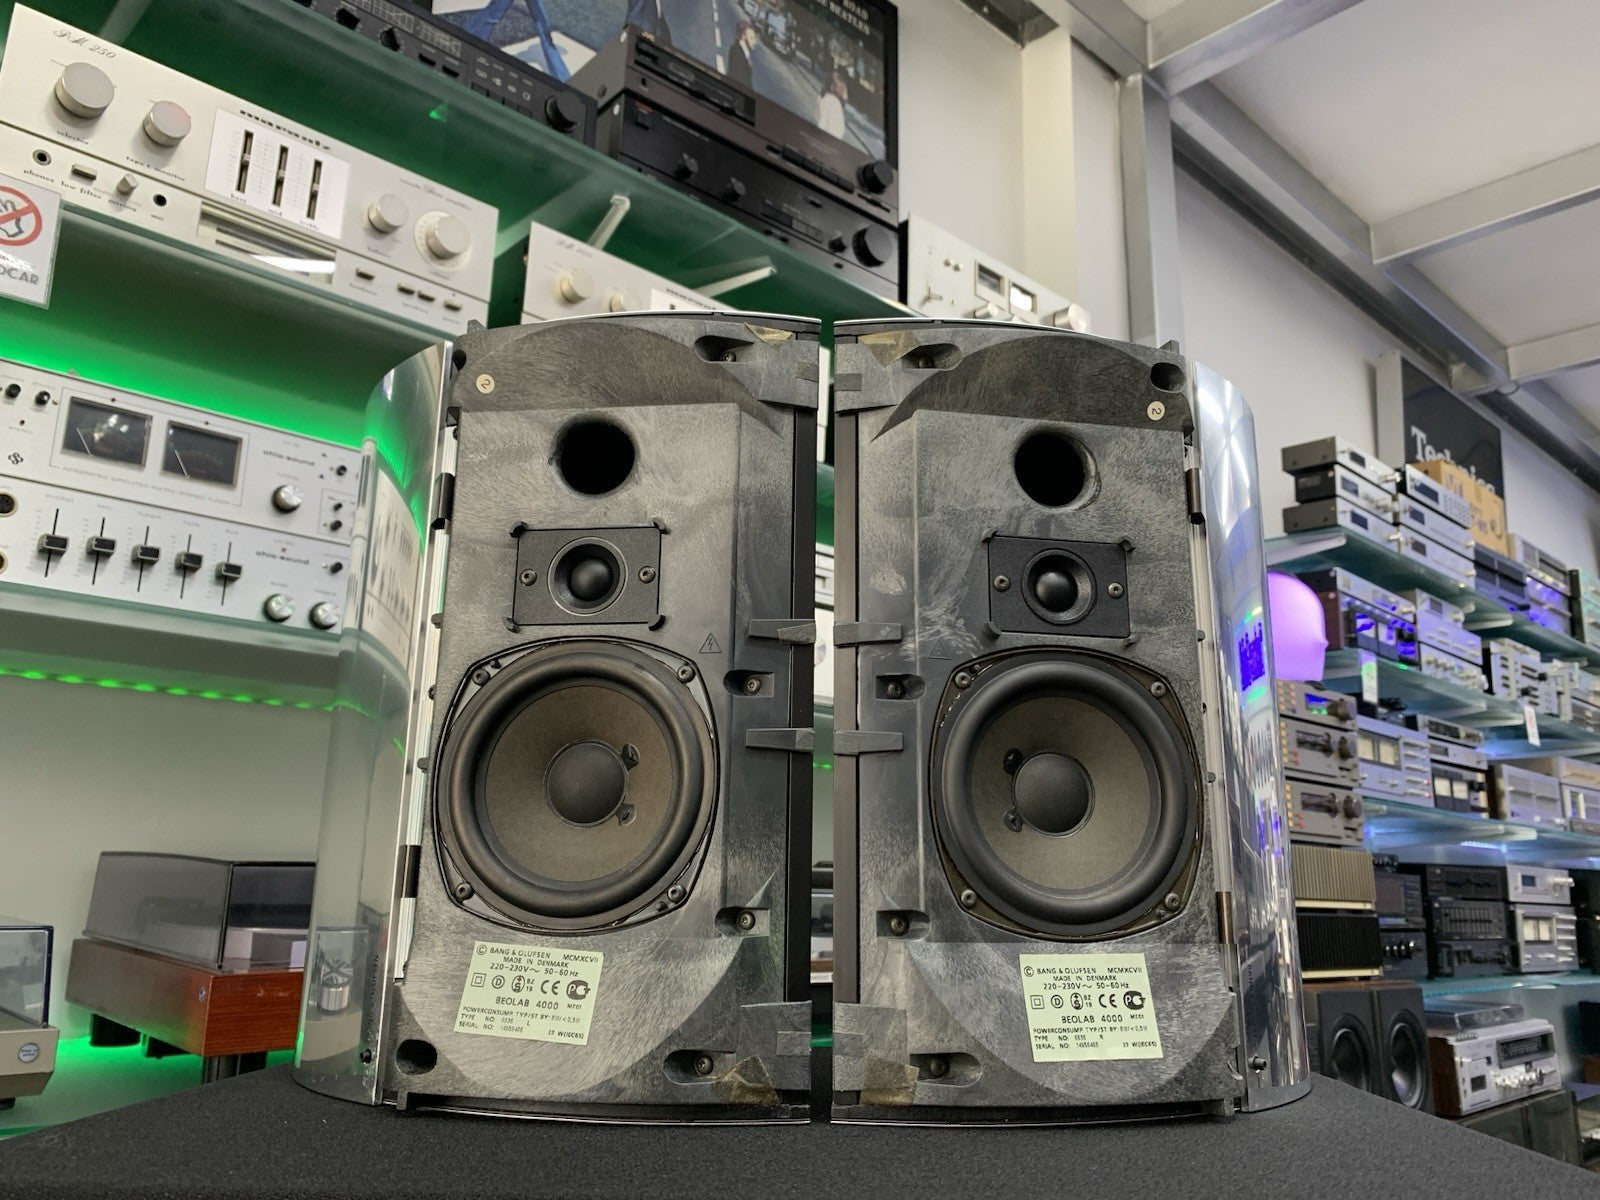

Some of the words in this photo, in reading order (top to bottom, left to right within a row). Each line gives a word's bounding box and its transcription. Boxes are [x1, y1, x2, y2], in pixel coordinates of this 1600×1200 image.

[240, 109, 330, 150] marantz
[23, 169, 54, 182] phones
[60, 180, 76, 190] low
[80, 188, 102, 200] filter
[490, 947, 510, 956] BANG
[518, 950, 551, 959] OLUFSEN
[503, 956, 522, 964] MADE
[537, 959, 570, 969] DENMARK
[570, 970, 580, 978] Hz
[540, 979, 561, 996] CE
[495, 996, 530, 1008] BEOLAB
[536, 1000, 559, 1011] 4000
[1098, 994, 1118, 1008] CE
[458, 1021, 478, 1029] SERIAL
[1061, 1015, 1095, 1024] BEOLAB
[1100, 1014, 1123, 1022] 4000
